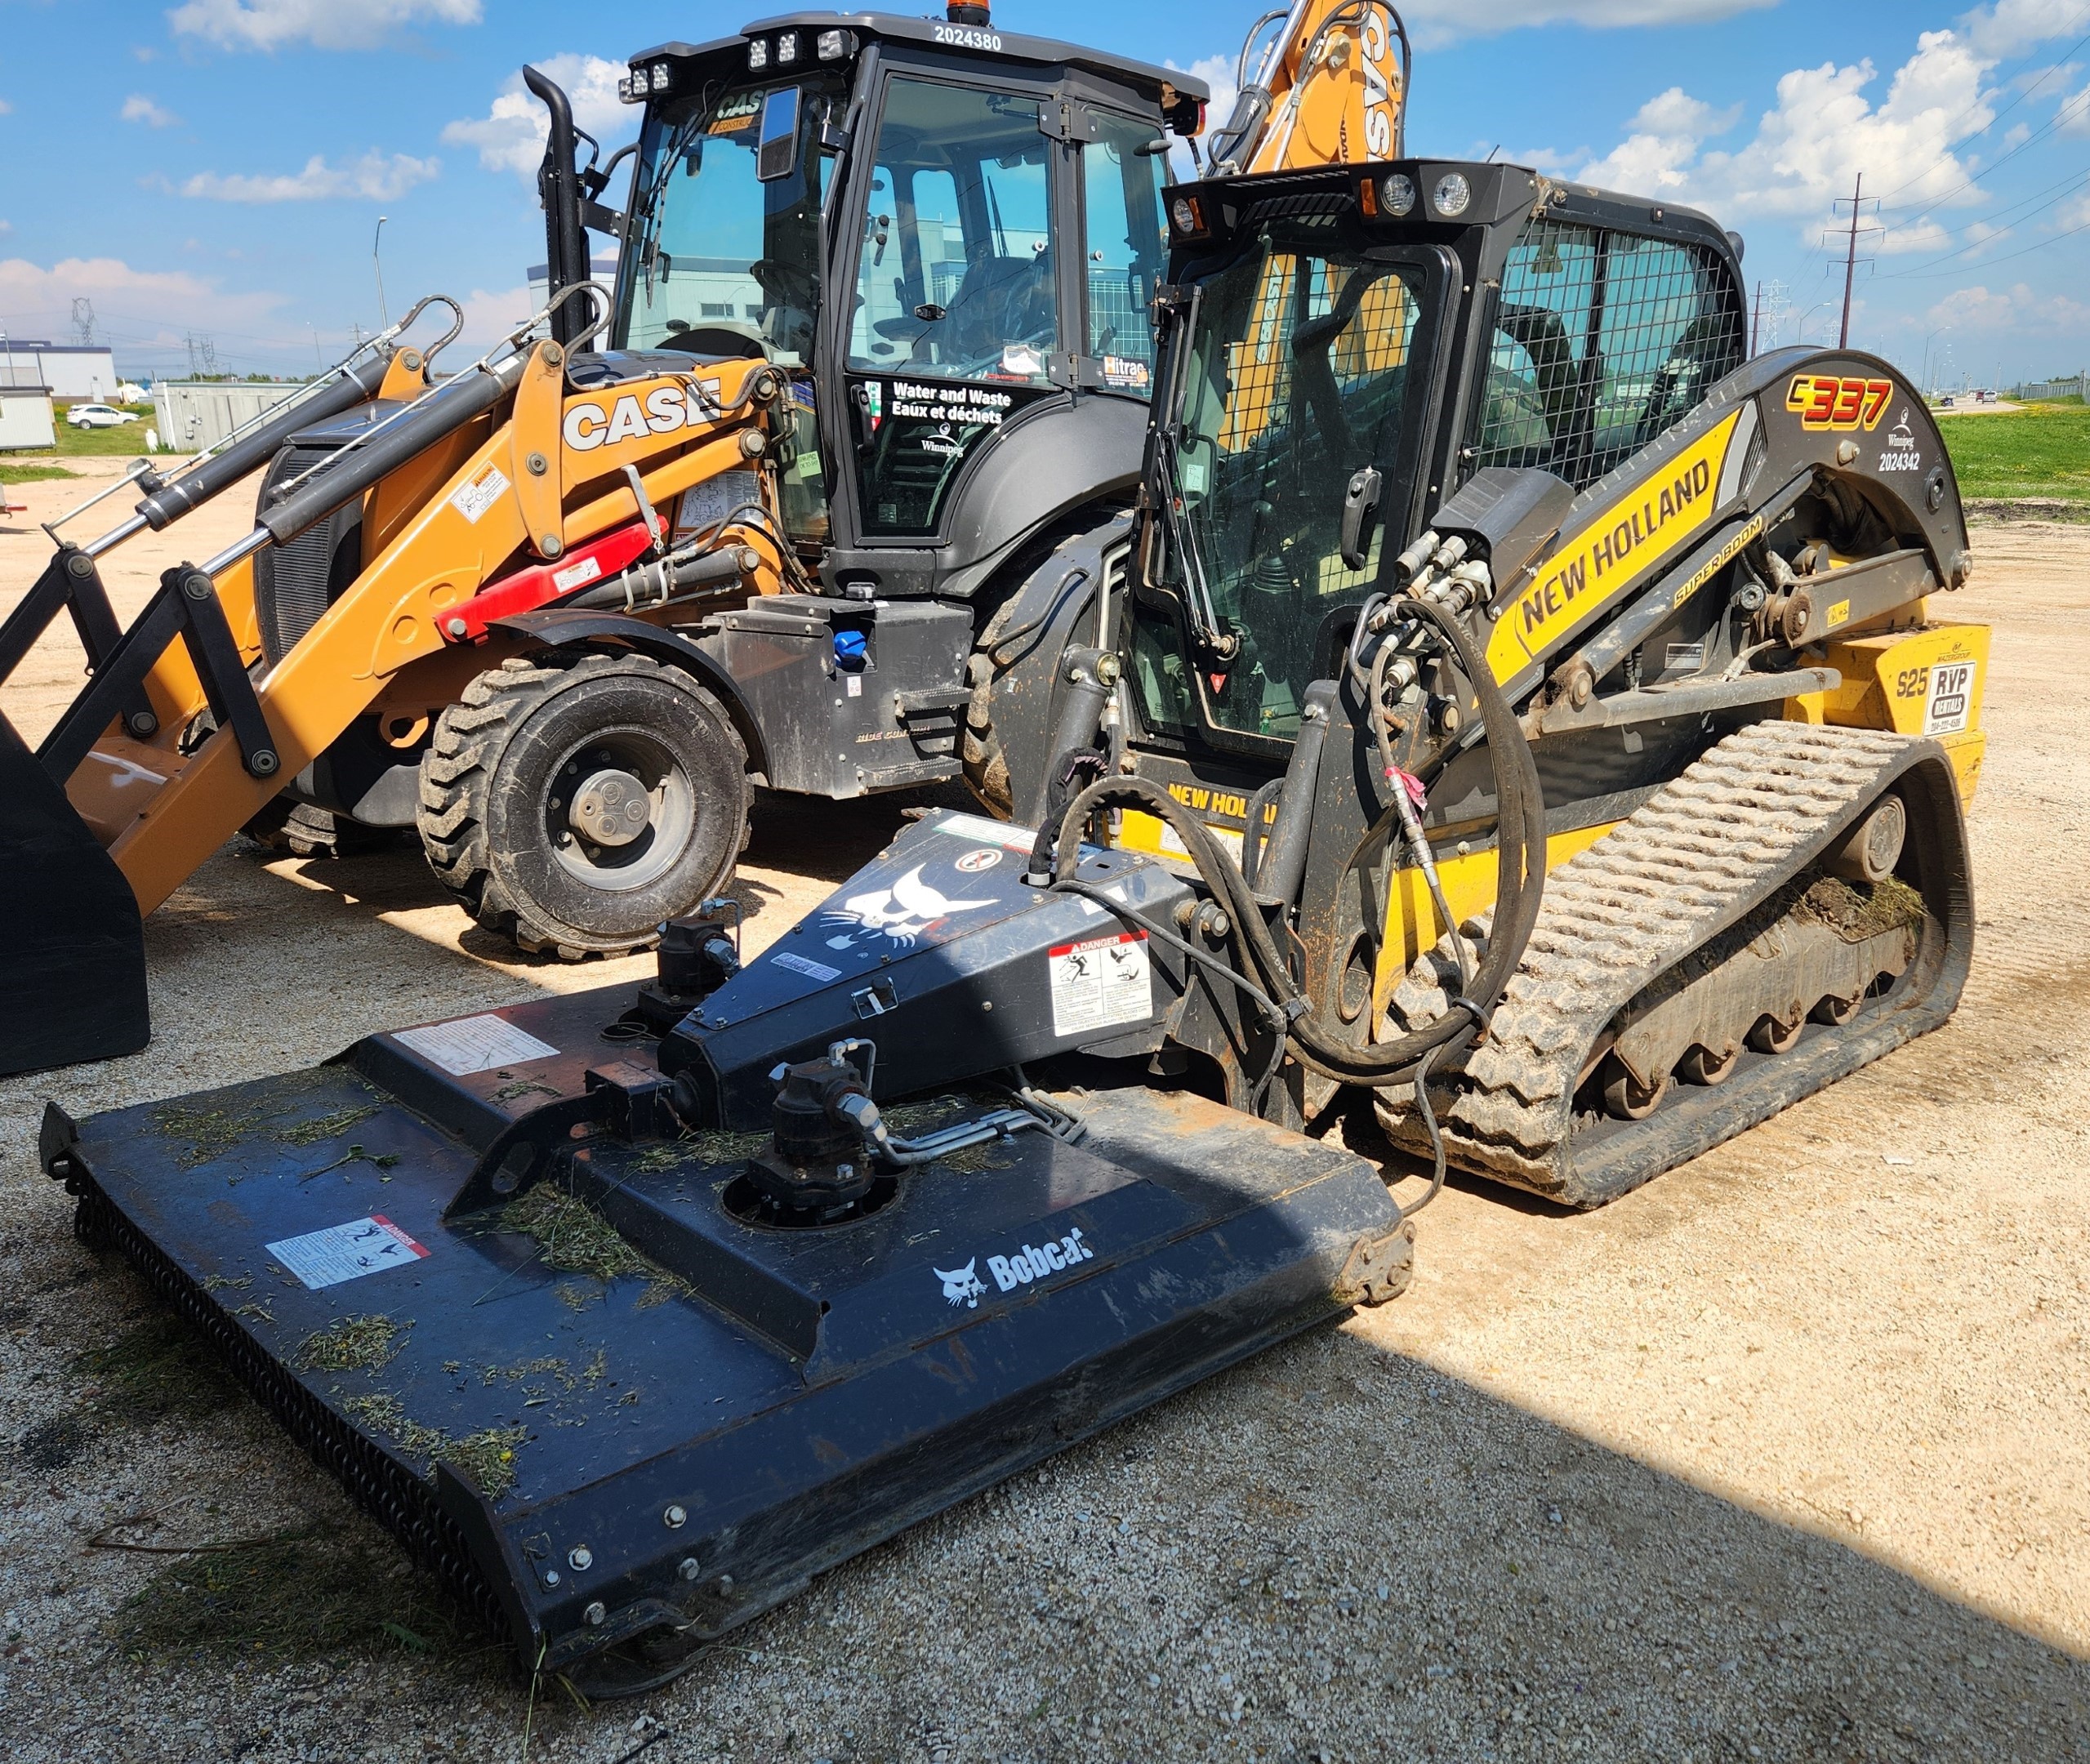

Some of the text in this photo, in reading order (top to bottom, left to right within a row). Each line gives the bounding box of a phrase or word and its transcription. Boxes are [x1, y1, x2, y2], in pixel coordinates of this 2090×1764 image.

[934, 25, 1001, 51] 2024380
[1359, 10, 1391, 163] CAS
[893, 381, 1011, 407] Water and Waste
[1786, 376, 1893, 430] C337
[563, 377, 722, 452] CASE
[892, 401, 1003, 425] Eaux et déchets
[921, 439, 965, 457] Winnipeg
[1887, 434, 1914, 451] Winnipeg
[1878, 452, 1920, 472] 2024342
[1521, 457, 1710, 635] NEW HOLLAND
[1674, 517, 1761, 604] SUPER BOOM
[1896, 666, 1929, 697] S25
[1936, 668, 1967, 695] RVP
[1935, 697, 1963, 715] RENTALS
[1168, 783, 1210, 809] NEW
[1079, 937, 1121, 951] DANGER
[387, 1226, 417, 1246] DANGER
[986, 1227, 1094, 1293] Bobcat
